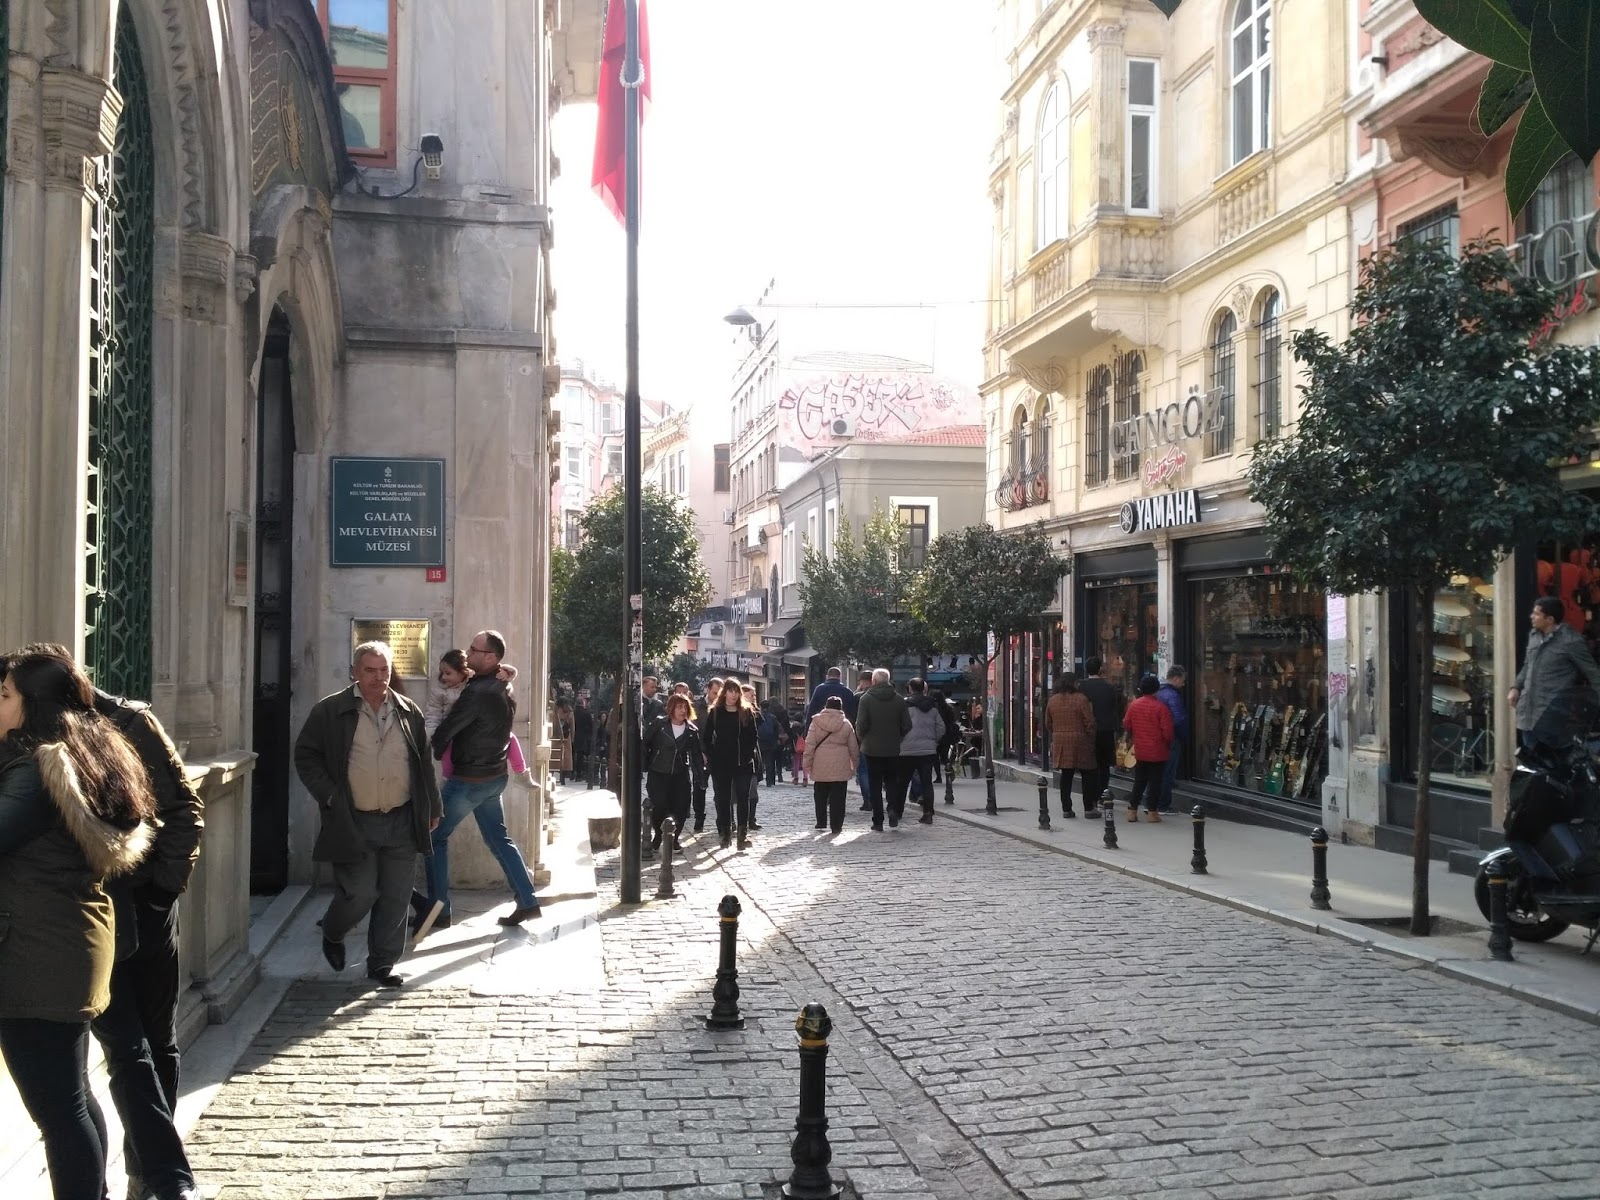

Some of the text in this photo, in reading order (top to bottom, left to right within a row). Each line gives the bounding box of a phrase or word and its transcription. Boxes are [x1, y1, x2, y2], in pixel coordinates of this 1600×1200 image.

[1109, 384, 1226, 461] CANGÖZ
[1166, 445, 1187, 482] Shop
[1137, 489, 1198, 531] YAMAHA
[364, 512, 412, 521] GALATA
[339, 525, 438, 537] MEVLEVİHANESİ
[365, 540, 411, 552] MÜZESİ
[431, 570, 442, 579] 15
